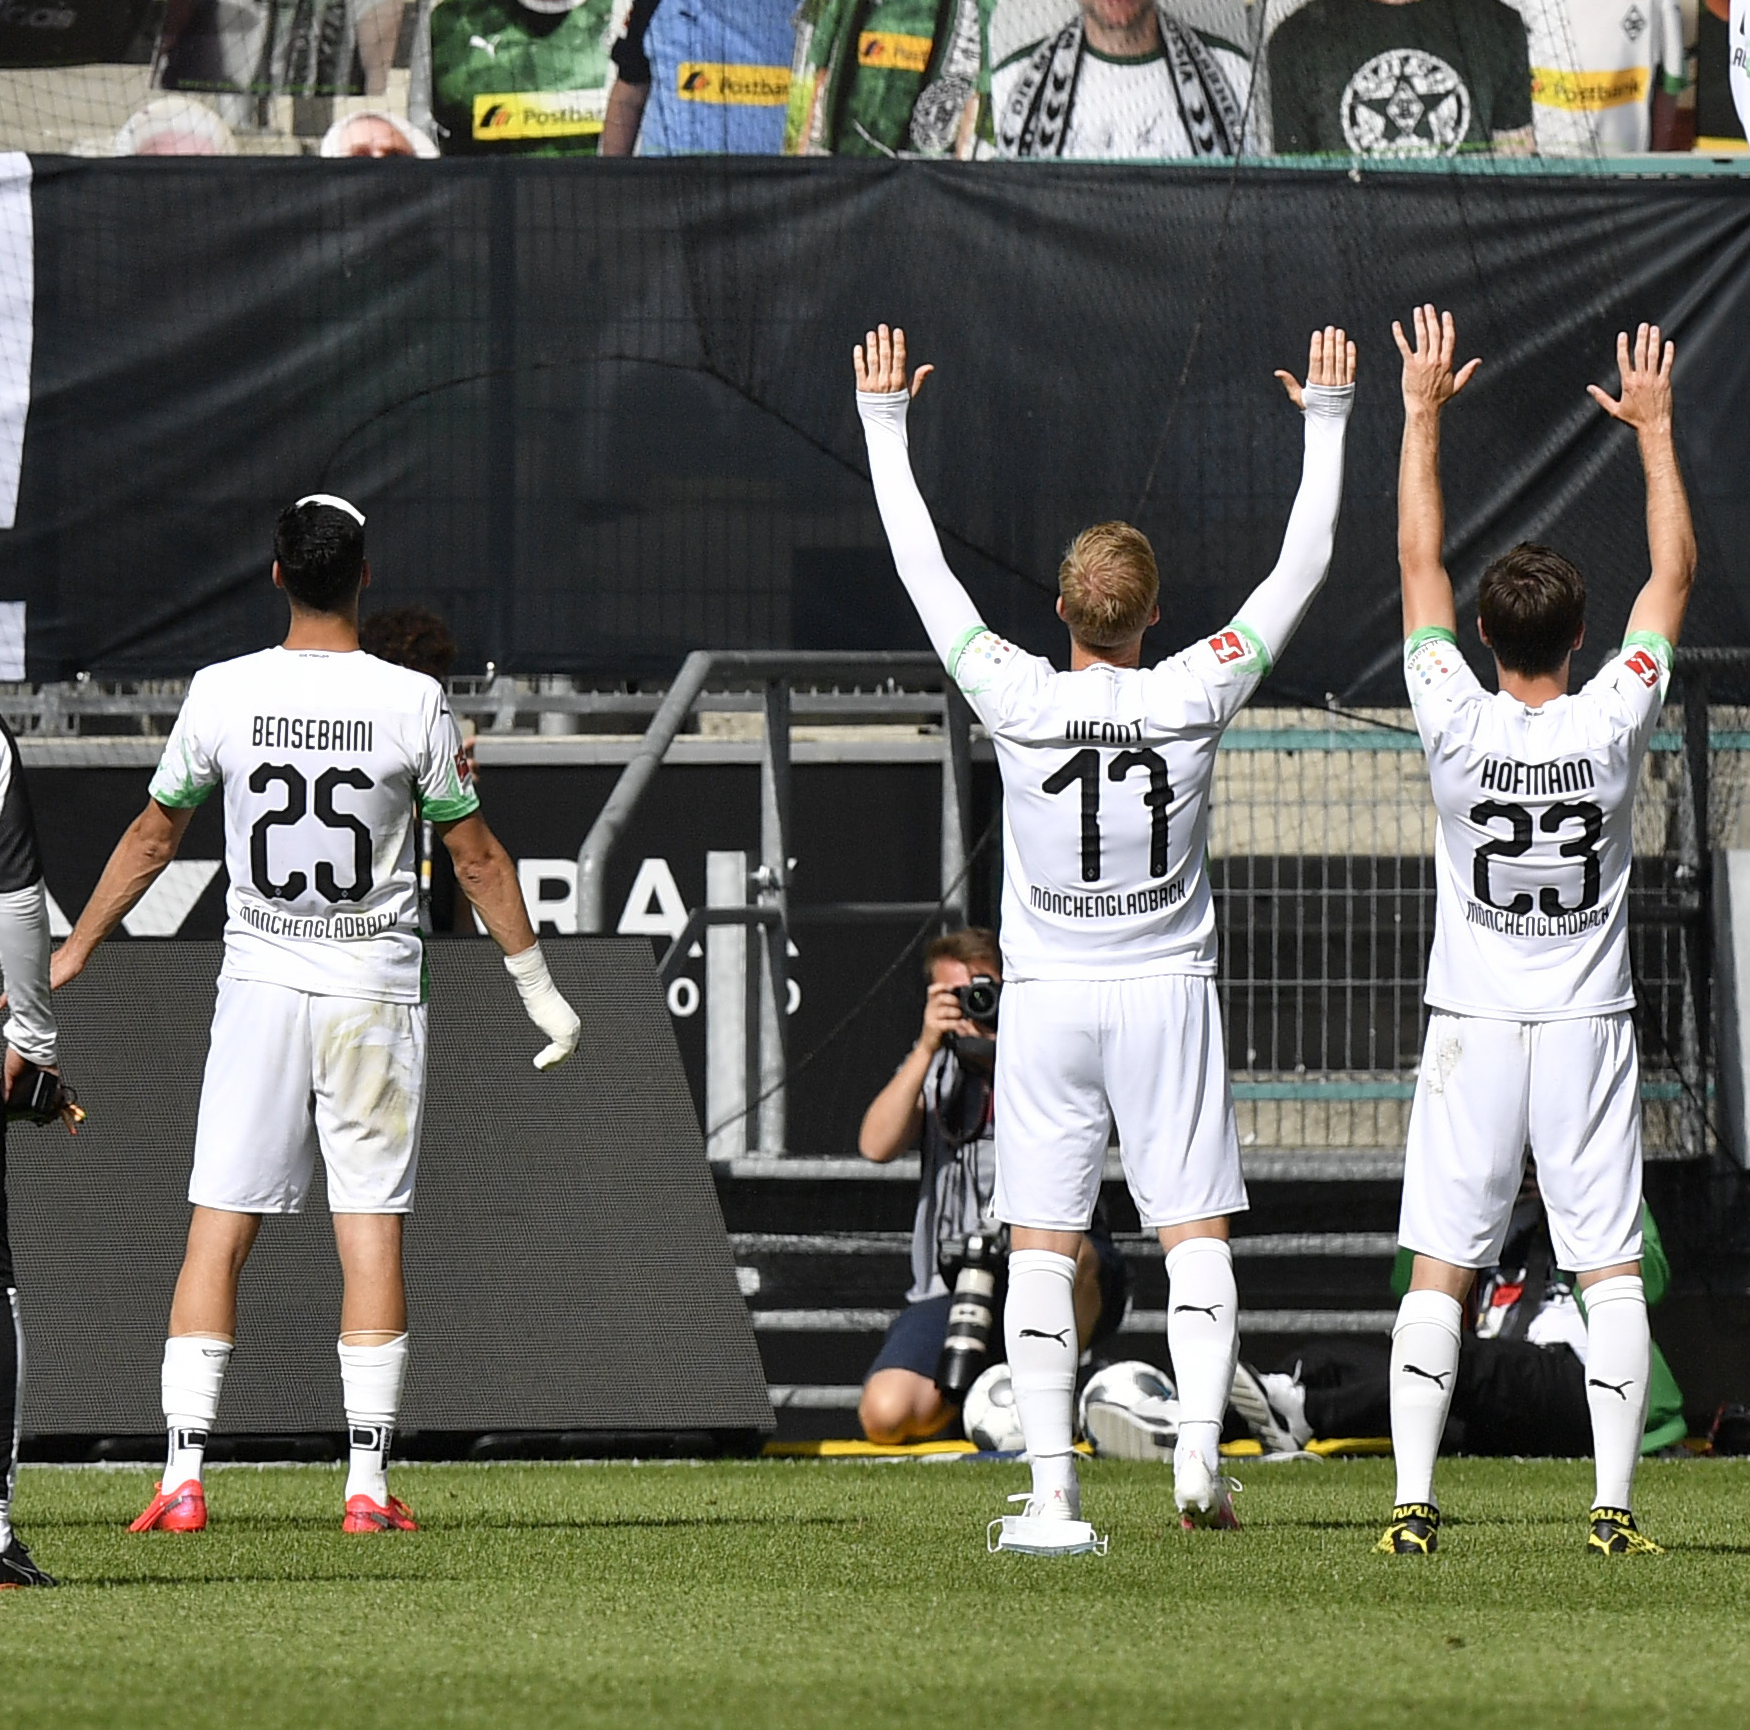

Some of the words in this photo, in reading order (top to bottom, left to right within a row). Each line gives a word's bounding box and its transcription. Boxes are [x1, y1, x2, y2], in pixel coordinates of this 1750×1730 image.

[252, 716, 373, 752] BENSEBAINI
[1041, 749, 1175, 883] 17
[1480, 758, 1595, 796] HOFMANN
[248, 761, 375, 902] 25
[1469, 799, 1603, 918] 23
[1030, 880, 1187, 920] MÖNCHENGLADBACH
